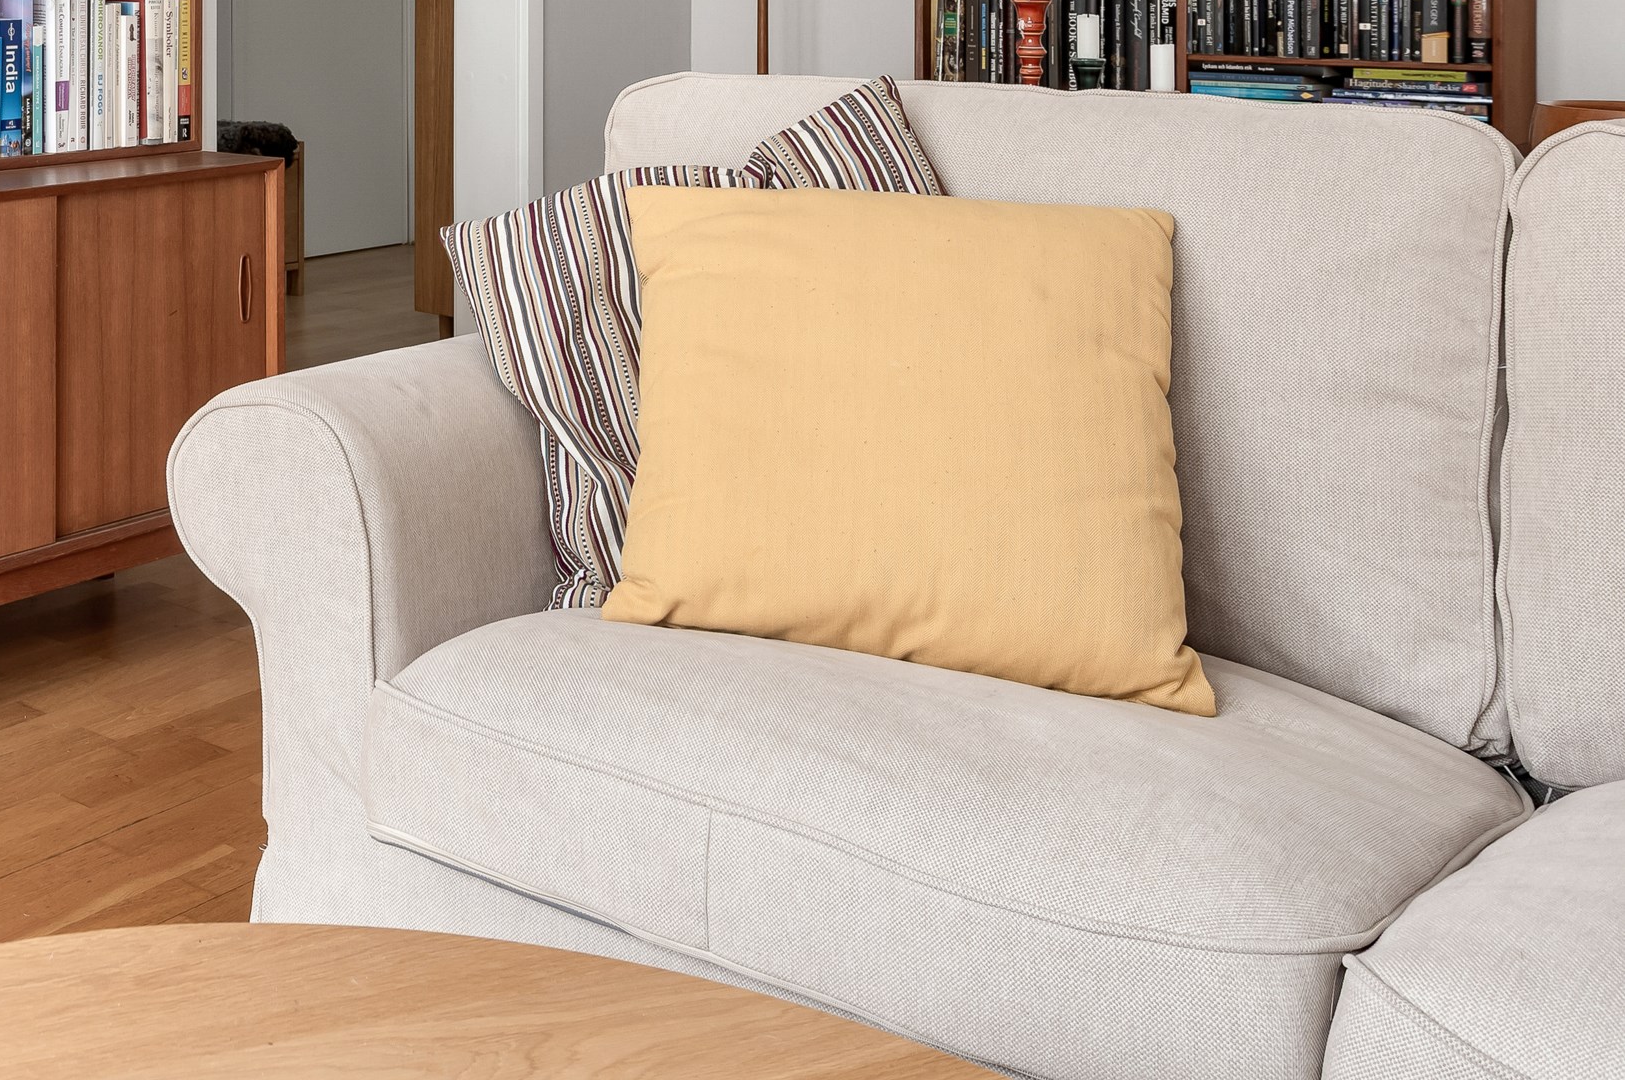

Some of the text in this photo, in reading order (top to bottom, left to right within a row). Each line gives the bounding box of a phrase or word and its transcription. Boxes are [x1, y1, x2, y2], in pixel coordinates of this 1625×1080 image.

[165, 11, 173, 58] Symboler
[1069, 12, 1077, 42] BOOK
[5, 45, 18, 93] India
[97, 75, 103, 85] BJ
[1349, 79, 1461, 92] Hagitude Sharon Blackie
